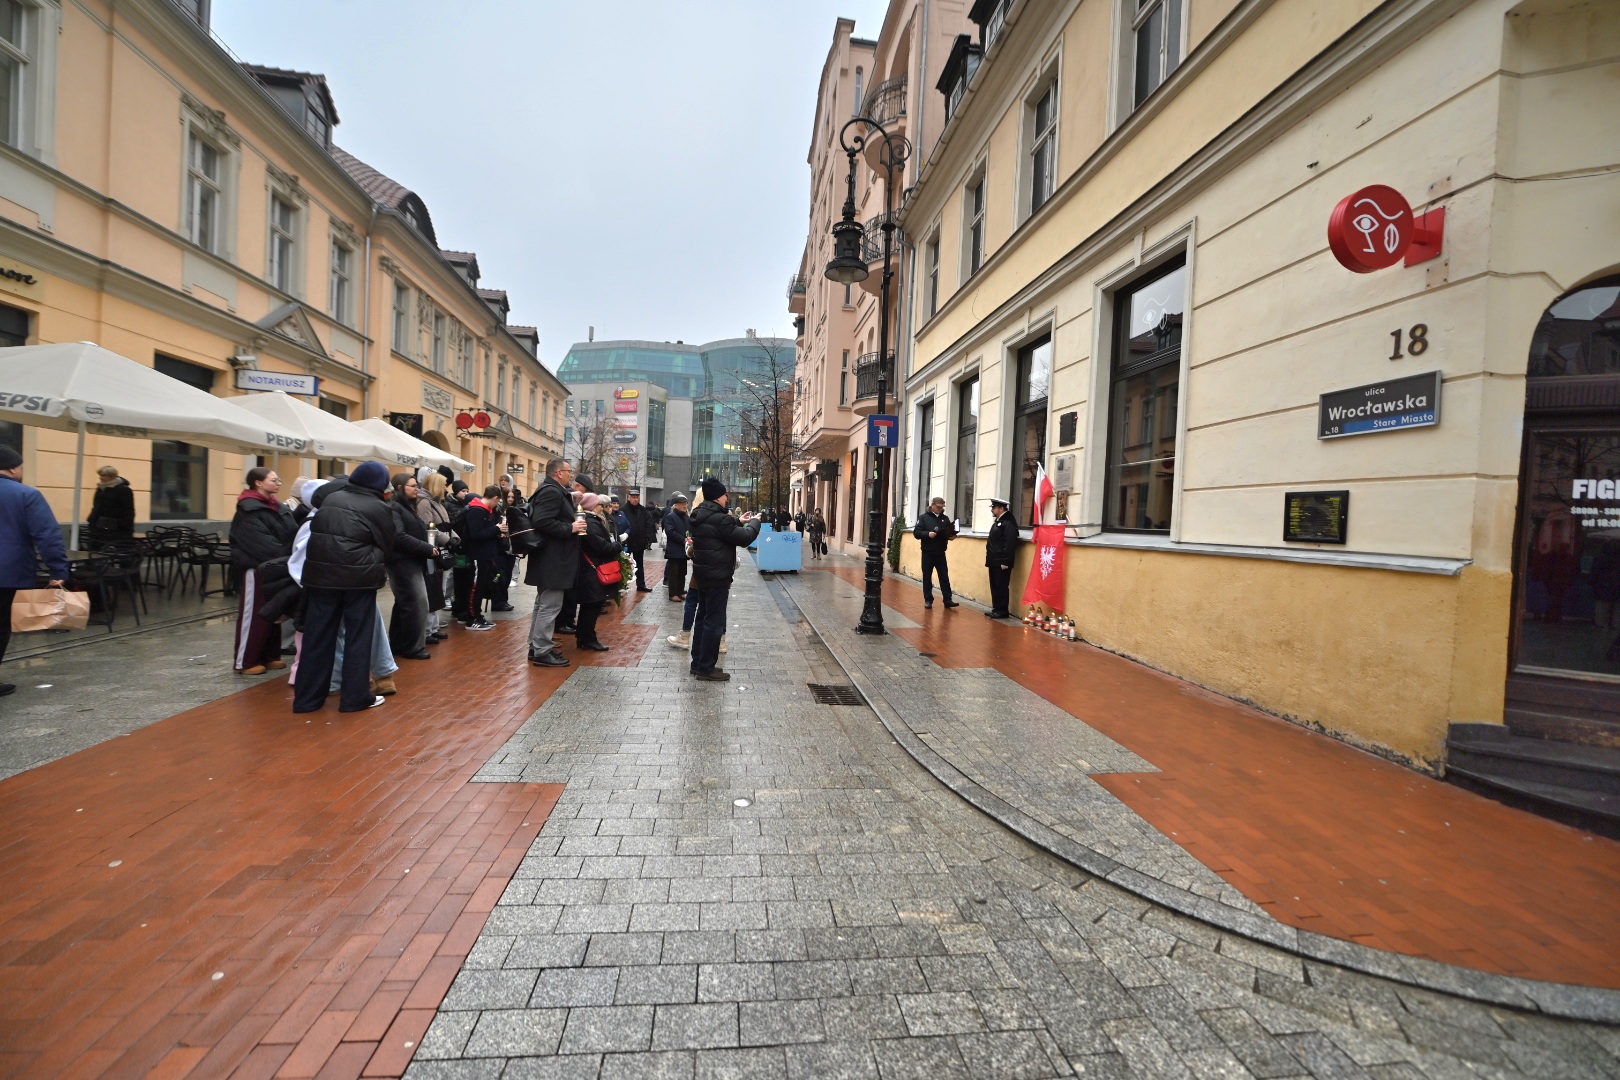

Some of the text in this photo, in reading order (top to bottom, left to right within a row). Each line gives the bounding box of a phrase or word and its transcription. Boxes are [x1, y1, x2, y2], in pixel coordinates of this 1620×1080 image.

[1388, 323, 1428, 360] 18
[247, 375, 306, 389] NOTARIUSZ
[1365, 387, 1386, 397] ulica
[1328, 394, 1427, 421] Wrocławska
[1373, 413, 1434, 428] Stare Miasto
[1331, 426, 1339, 434] 18
[265, 432, 307, 450] PEPSI
[396, 453, 418, 465] PEPSI
[1581, 518, 1596, 527] od
